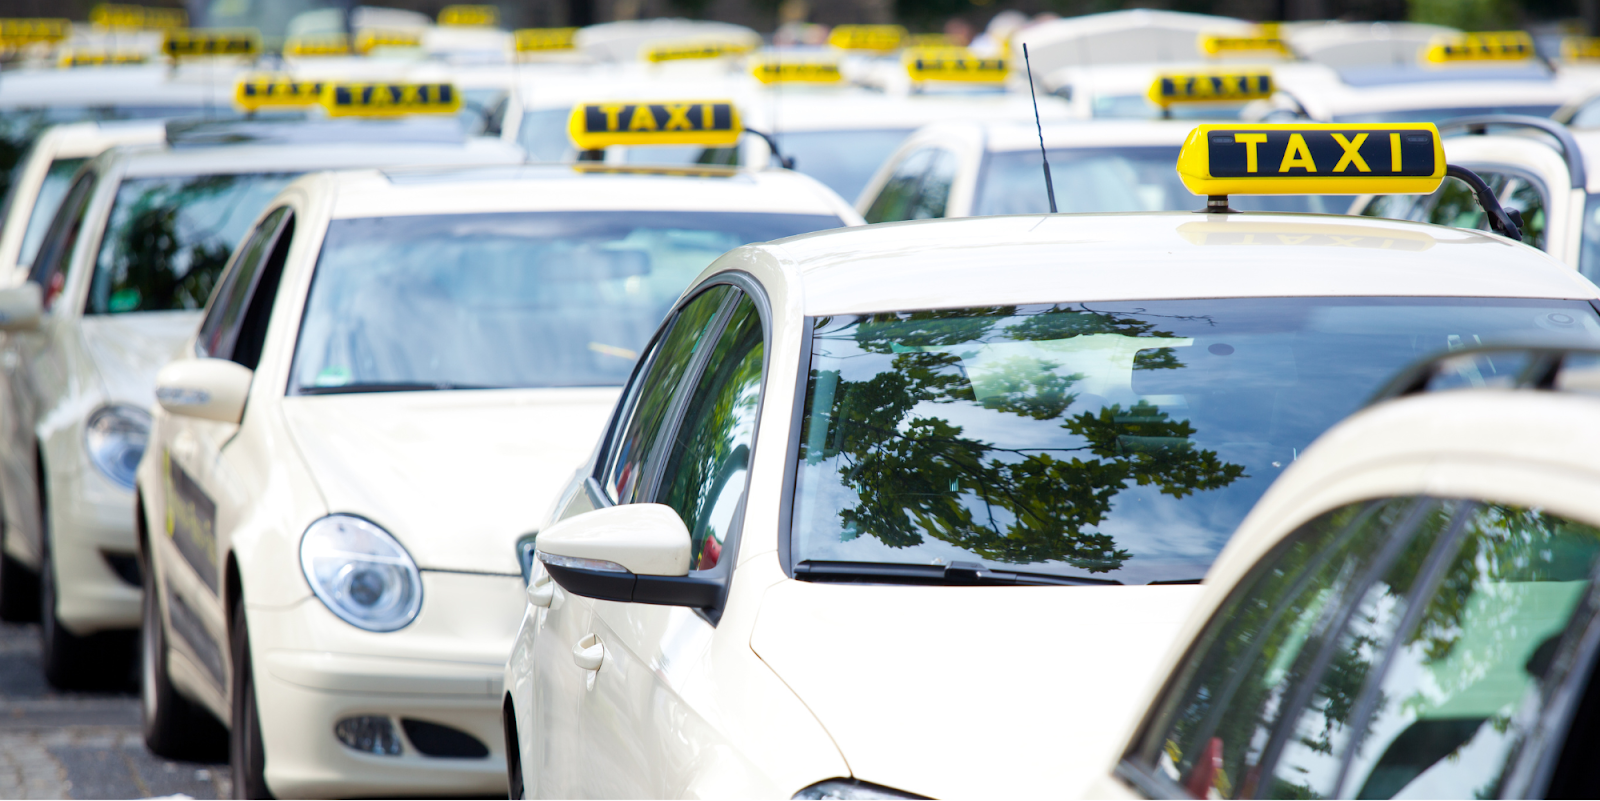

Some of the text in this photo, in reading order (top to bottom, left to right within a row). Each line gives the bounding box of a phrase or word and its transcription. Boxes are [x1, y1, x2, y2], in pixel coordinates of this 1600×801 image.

[347, 83, 441, 105] TAXI
[1172, 76, 1259, 96] TAXI
[598, 103, 714, 131] TAXI
[1234, 133, 1404, 173] TAXI
